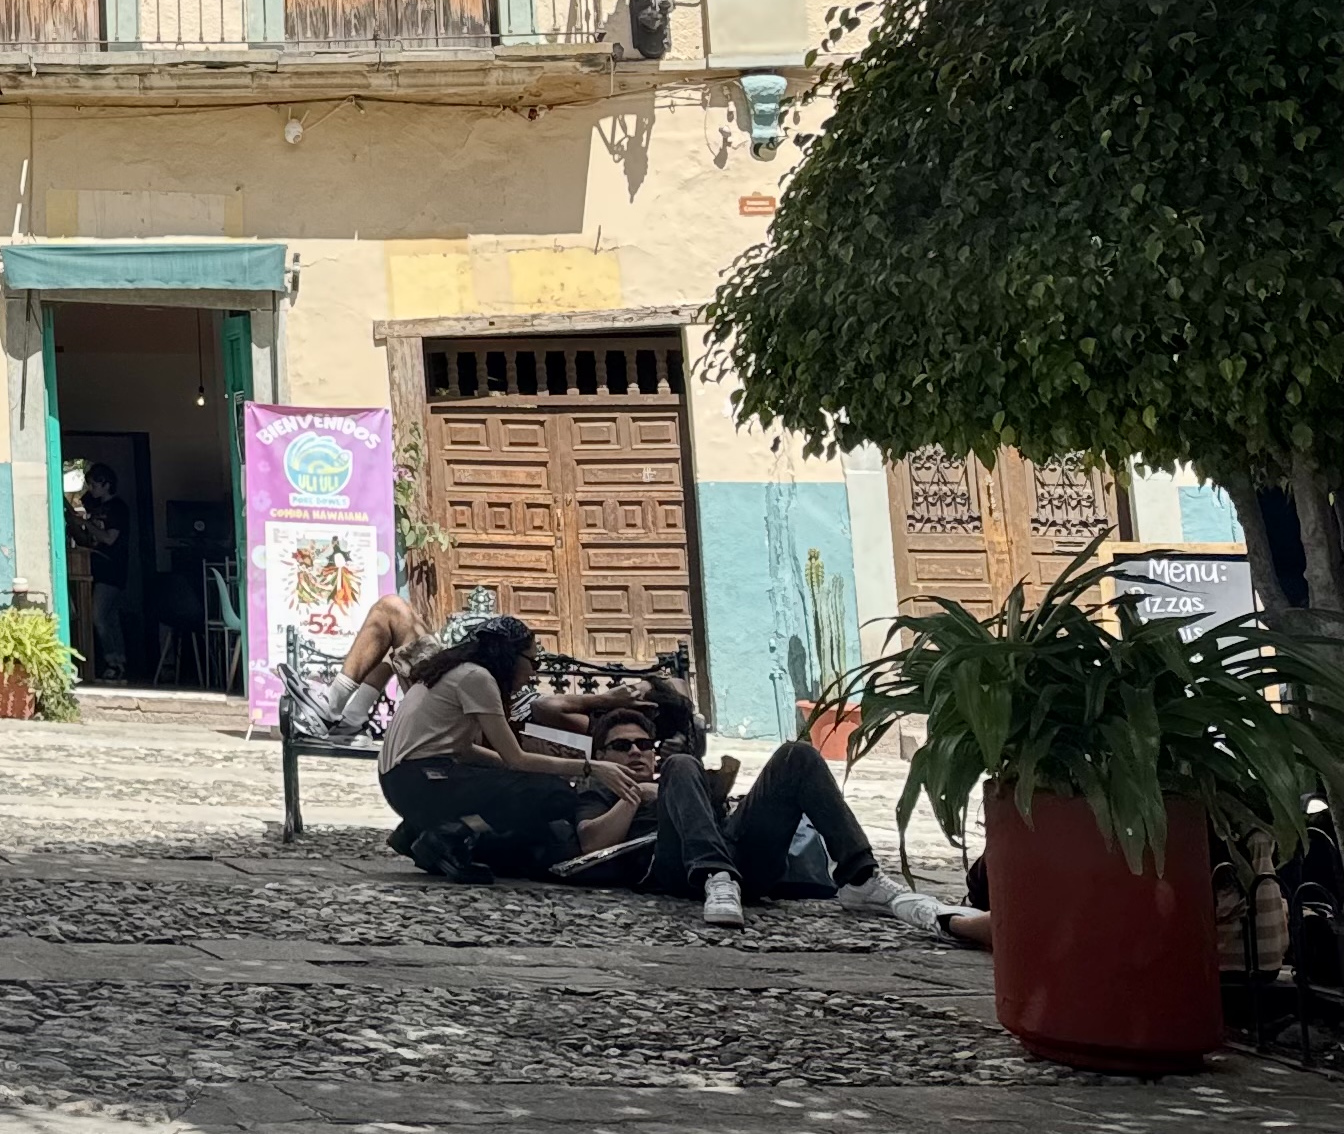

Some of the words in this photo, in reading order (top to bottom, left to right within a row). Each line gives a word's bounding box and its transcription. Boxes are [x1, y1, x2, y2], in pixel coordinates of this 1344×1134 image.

[255, 414, 382, 449] BIENVENIDOS
[298, 473, 318, 492] ULI
[319, 474, 339, 492] ULI
[269, 508, 310, 520] COMIDA
[312, 510, 369, 522] HAWAIANA
[1148, 558, 1227, 583] Menu:
[308, 614, 337, 635] 52
